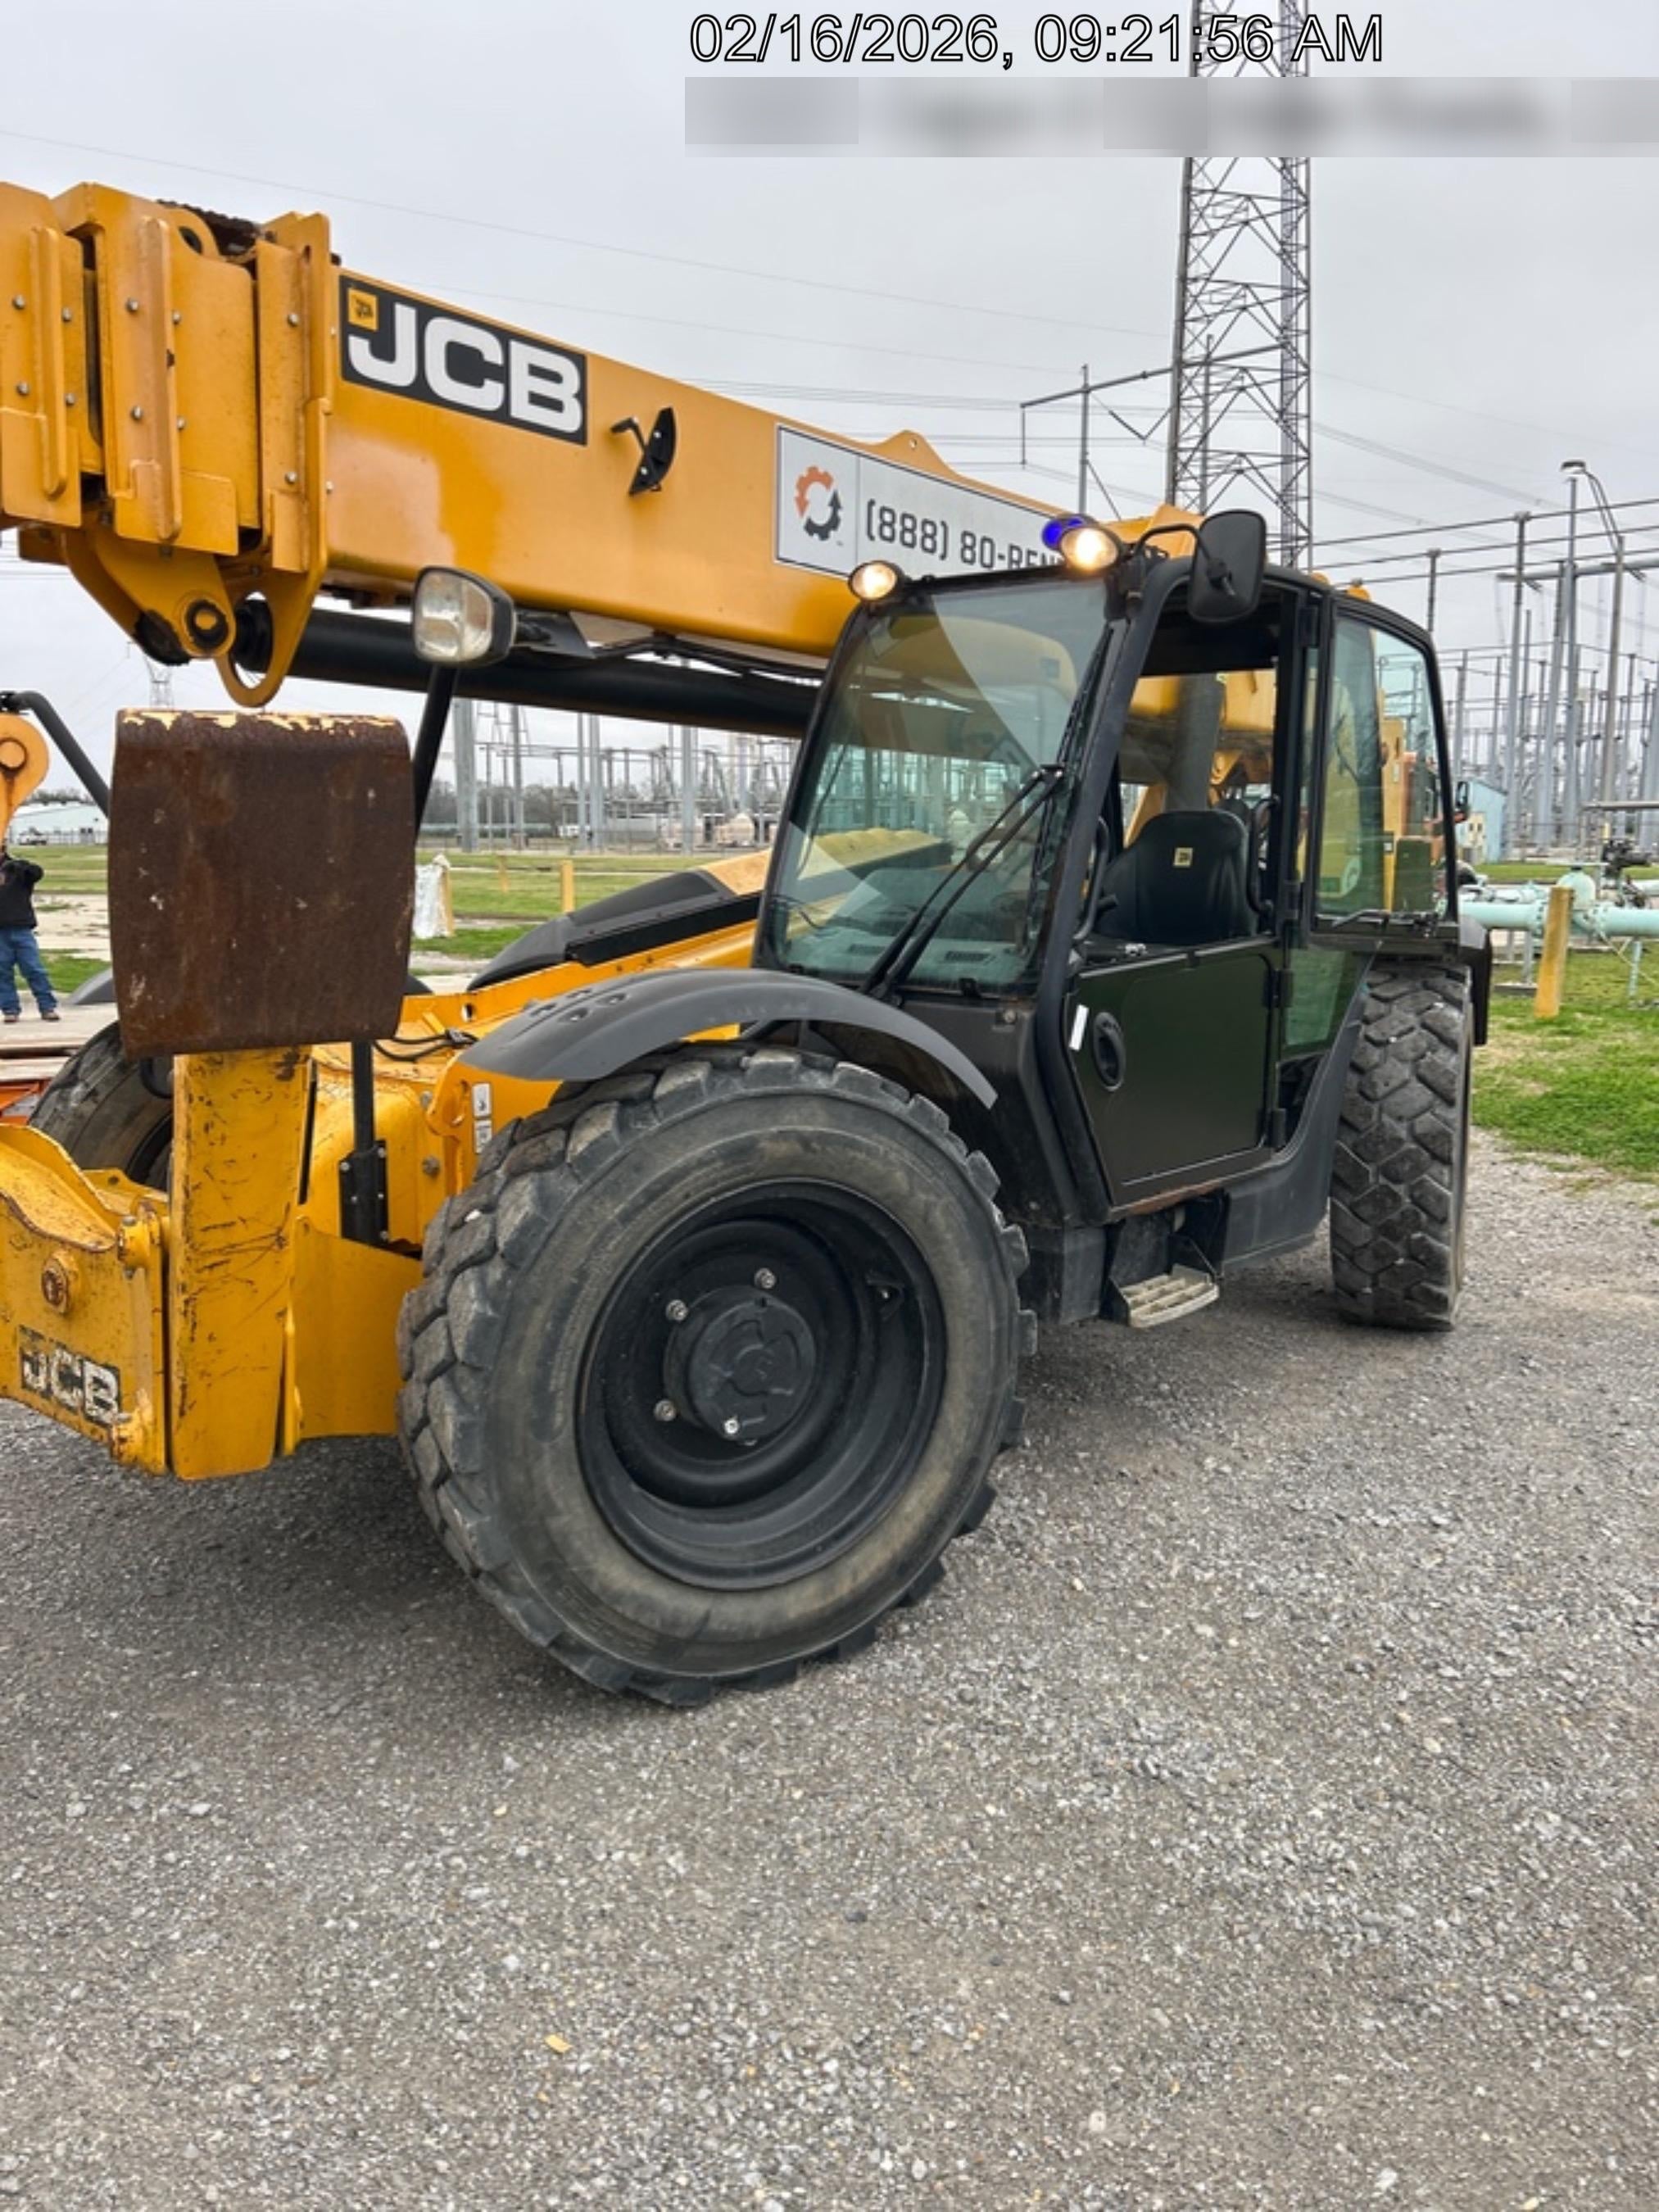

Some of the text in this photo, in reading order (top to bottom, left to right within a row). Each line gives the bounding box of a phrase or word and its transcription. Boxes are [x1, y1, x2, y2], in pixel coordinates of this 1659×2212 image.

[347, 302, 583, 433] JCB
[866, 498, 949, 561] (888)
[23, 1348, 119, 1423] JCB
